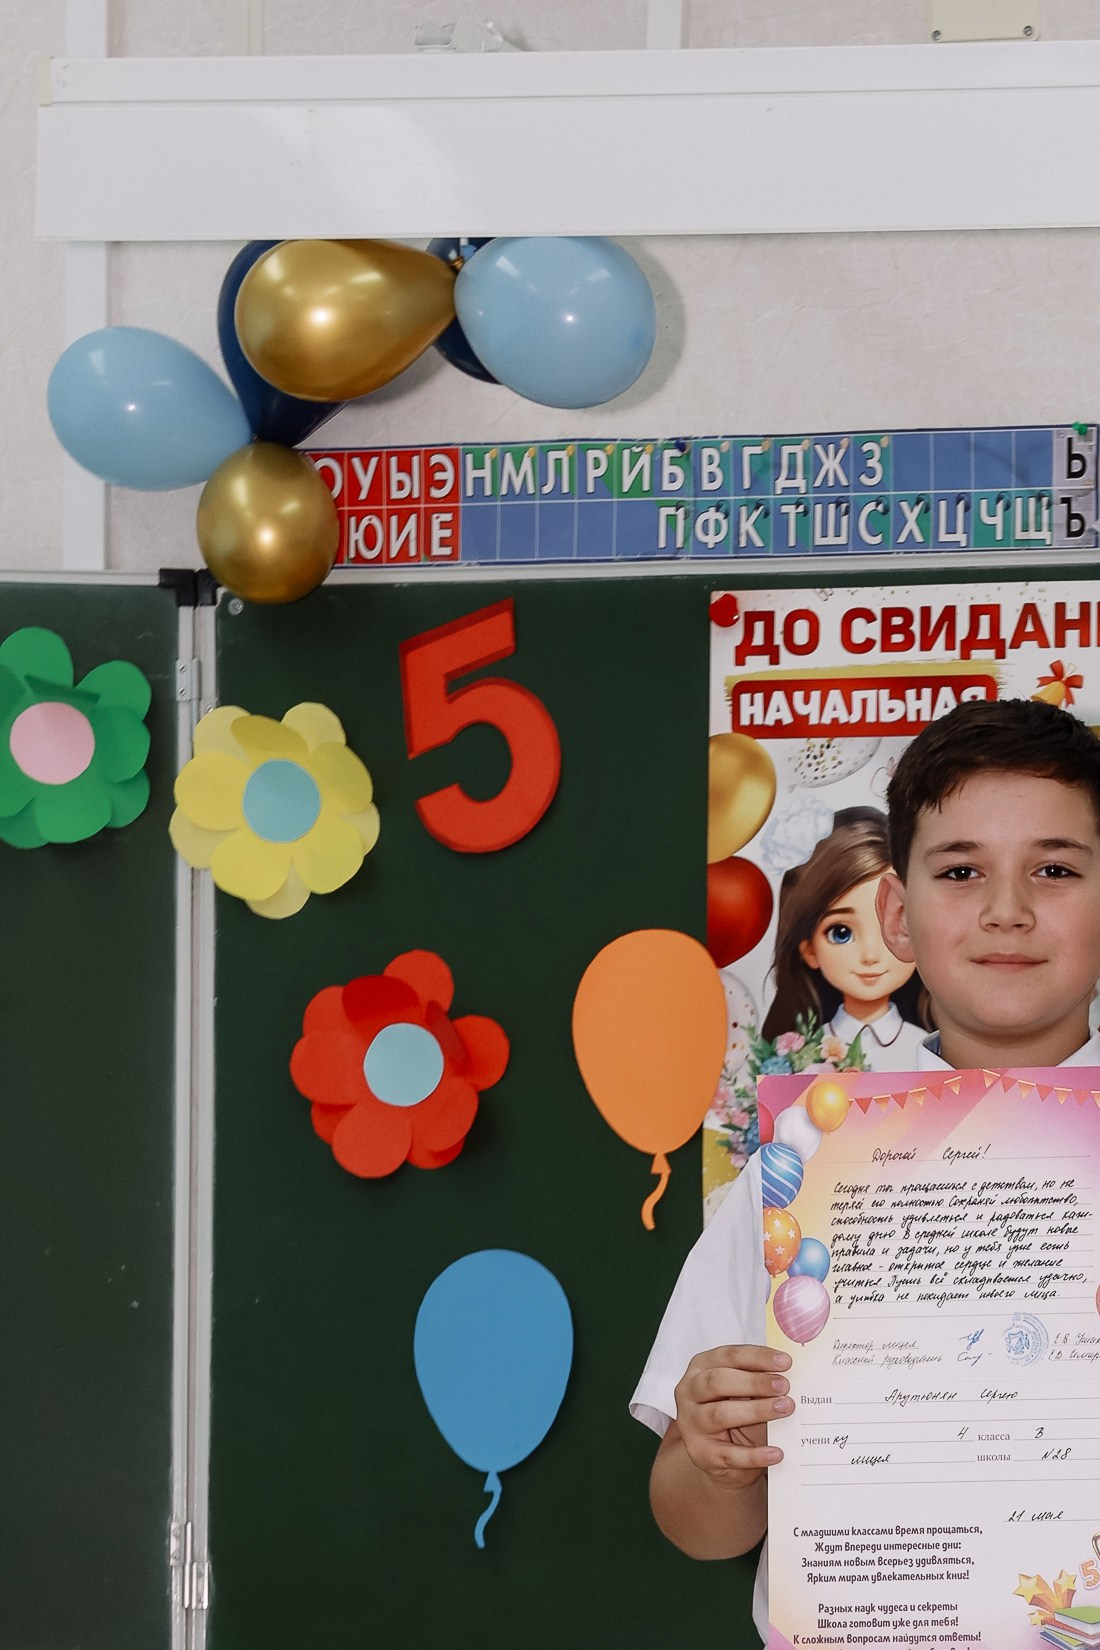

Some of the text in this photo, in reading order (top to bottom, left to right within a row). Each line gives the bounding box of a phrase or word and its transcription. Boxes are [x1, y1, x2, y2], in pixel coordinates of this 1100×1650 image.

[351, 456, 379, 500] У
[390, 455, 420, 499] Ы
[430, 454, 455, 499] Э
[466, 452, 492, 497] Н
[501, 452, 535, 496] М
[542, 451, 570, 494] Л
[586, 450, 608, 494] Р
[622, 446, 651, 492] Й
[661, 449, 686, 492] Б
[700, 444, 721, 492] В
[741, 445, 763, 489] Г
[774, 445, 806, 495] Д
[813, 442, 849, 487] Ж
[1065, 436, 1086, 480] Ь
[349, 497, 1086, 560] Ю И Е П Ф К Т Ш С Х Ц Ч Щ Ъ
[734, 609, 820, 667] ДО
[398, 597, 562, 855] 5
[942, 1144, 991, 1165] Сергей!
[834, 1181, 870, 1198] Сегодня
[876, 1182, 894, 1193] ты
[971, 1182, 978, 1191] с
[1042, 1178, 1056, 1190] но
[1060, 1178, 1075, 1189] не
[831, 1199, 863, 1216] теряй
[976, 1213, 983, 1222] и
[903, 1226, 911, 1240] В
[882, 1246, 890, 1256] и
[944, 1244, 960, 1254] но
[963, 1246, 972, 1258] у
[998, 1259, 1006, 1268] и
[835, 1293, 843, 1304] а
[897, 1291, 910, 1301] не
[800, 1396, 832, 1404] Выдан
[958, 1428, 969, 1440] 4
[978, 1432, 1010, 1442] класса
[977, 1452, 1011, 1462] школы
[1008, 1510, 1025, 1522] 21
[793, 1525, 983, 1539] С младшими классами время прощаться,
[815, 1542, 962, 1554] Ждут впереди интересные дни:
[801, 1555, 975, 1568] Знаниям новым всерьез удивляться,
[807, 1569, 969, 1585] Ярким мирам увлекательных книг!
[818, 1602, 958, 1615] Разных наук чудеса и секреты
[817, 1616, 959, 1629] Школа готовит уже для тебя!
[793, 1631, 981, 1645] К сложным вопросам найдутся ответы!
